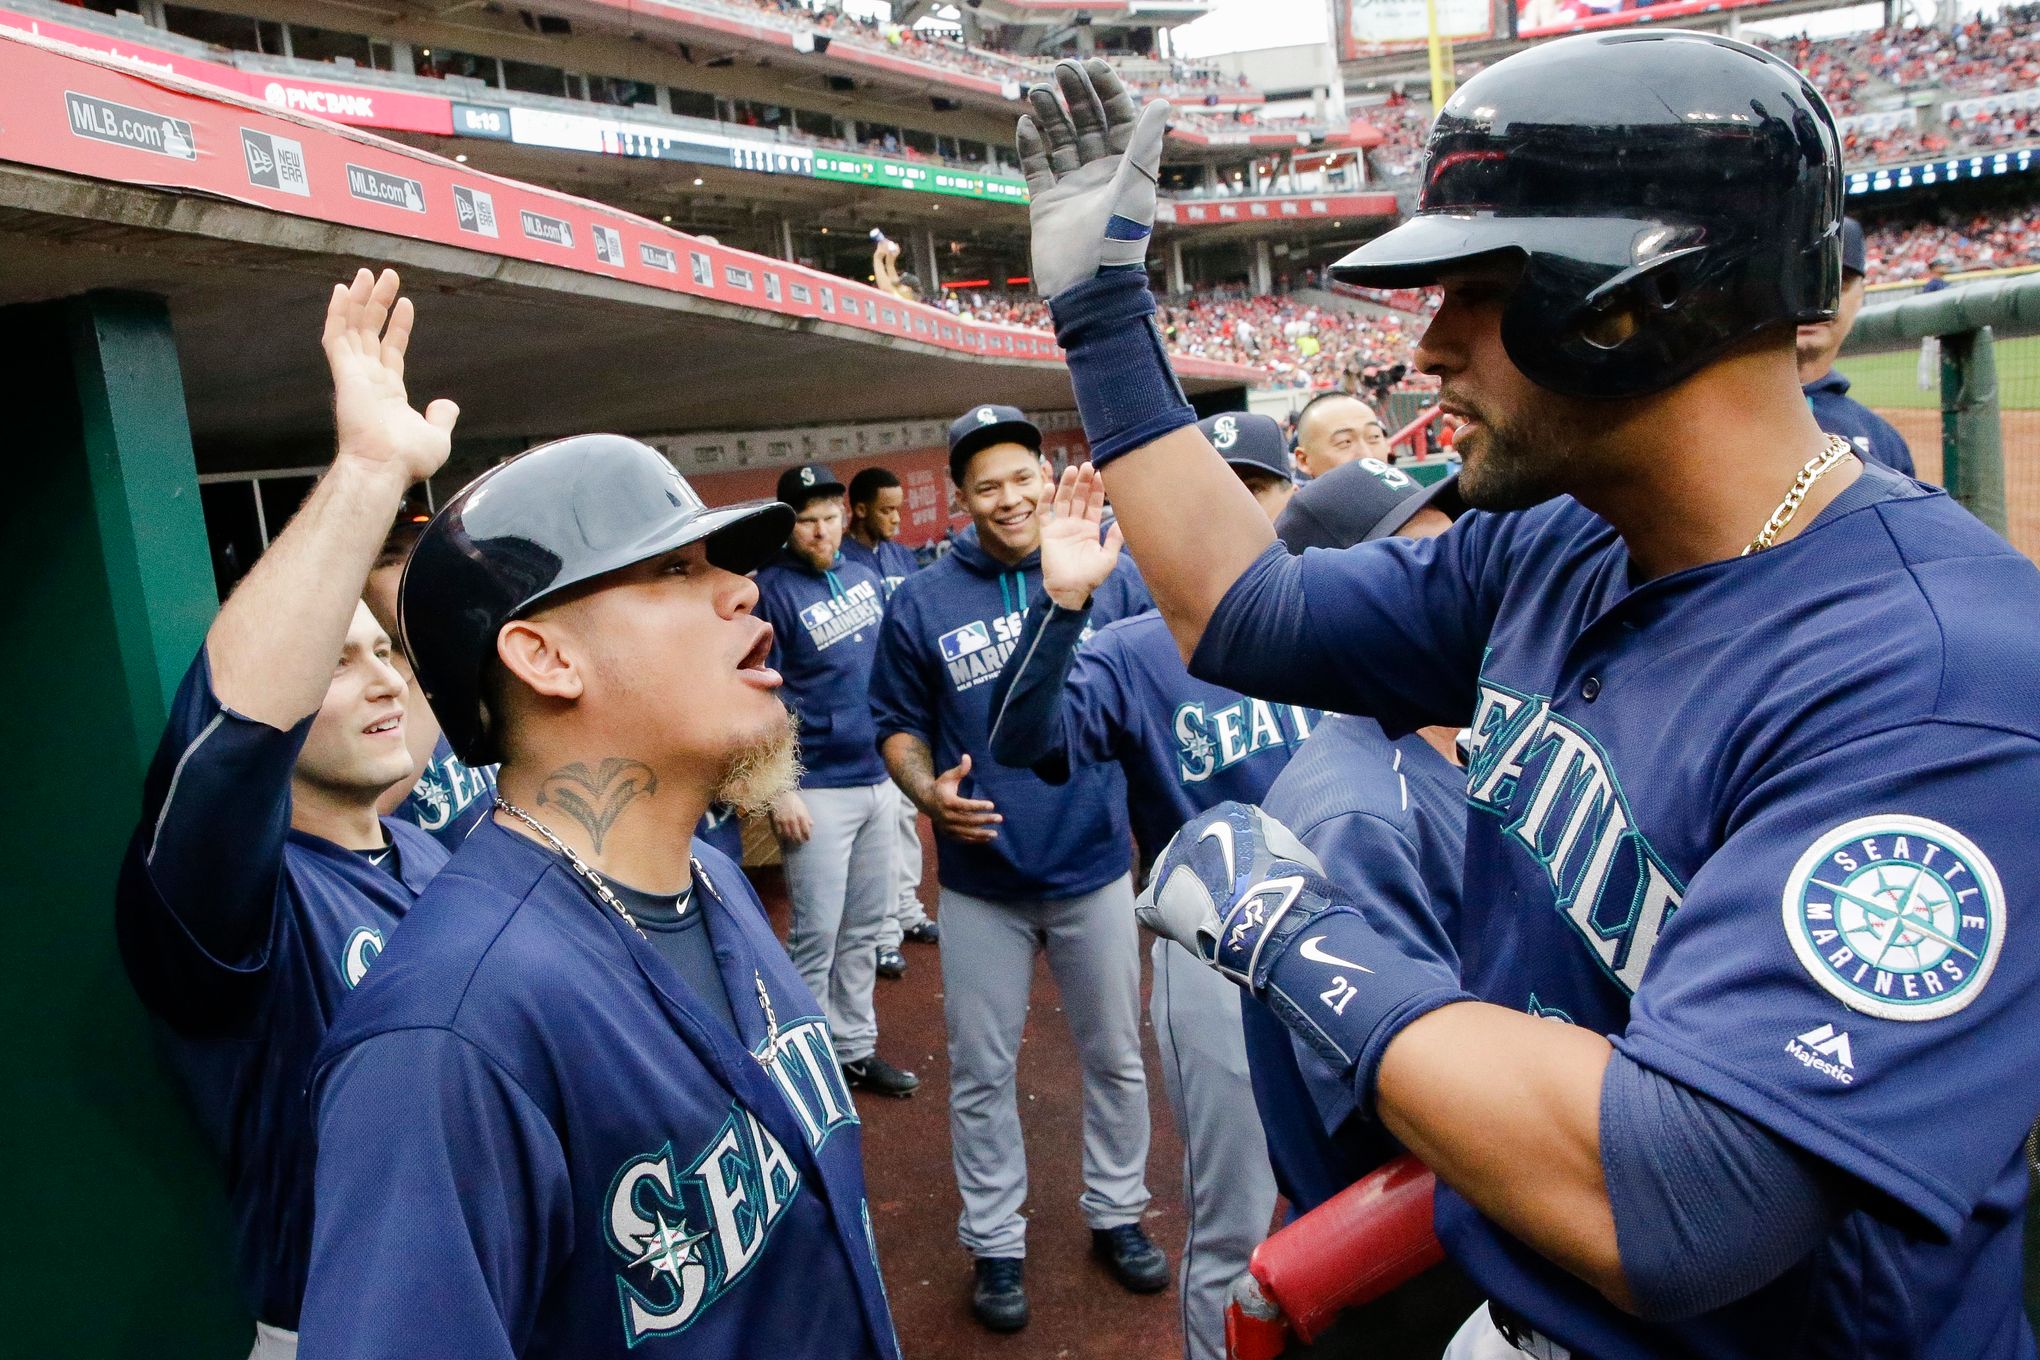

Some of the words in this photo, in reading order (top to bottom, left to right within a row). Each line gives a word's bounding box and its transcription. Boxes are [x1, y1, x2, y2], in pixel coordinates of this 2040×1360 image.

[71, 99, 162, 147] MLB.com
[277, 147, 301, 167] NEW
[281, 167, 304, 185] ERA
[349, 170, 405, 203] MLB.com
[476, 200, 493, 215] NEW
[479, 212, 495, 228] ERA
[522, 215, 562, 243] MLB.com
[1213, 415, 1238, 450] S
[800, 466, 816, 486] S
[809, 600, 875, 647] MARINERS
[992, 607, 1030, 643] SE
[1174, 697, 1341, 782] SEAT
[1833, 836, 1986, 930] SEATTLE
[1806, 902, 1964, 998] MARINERS
[1319, 975, 1358, 1017] 21
[1784, 1038, 1854, 1085] Majestic
